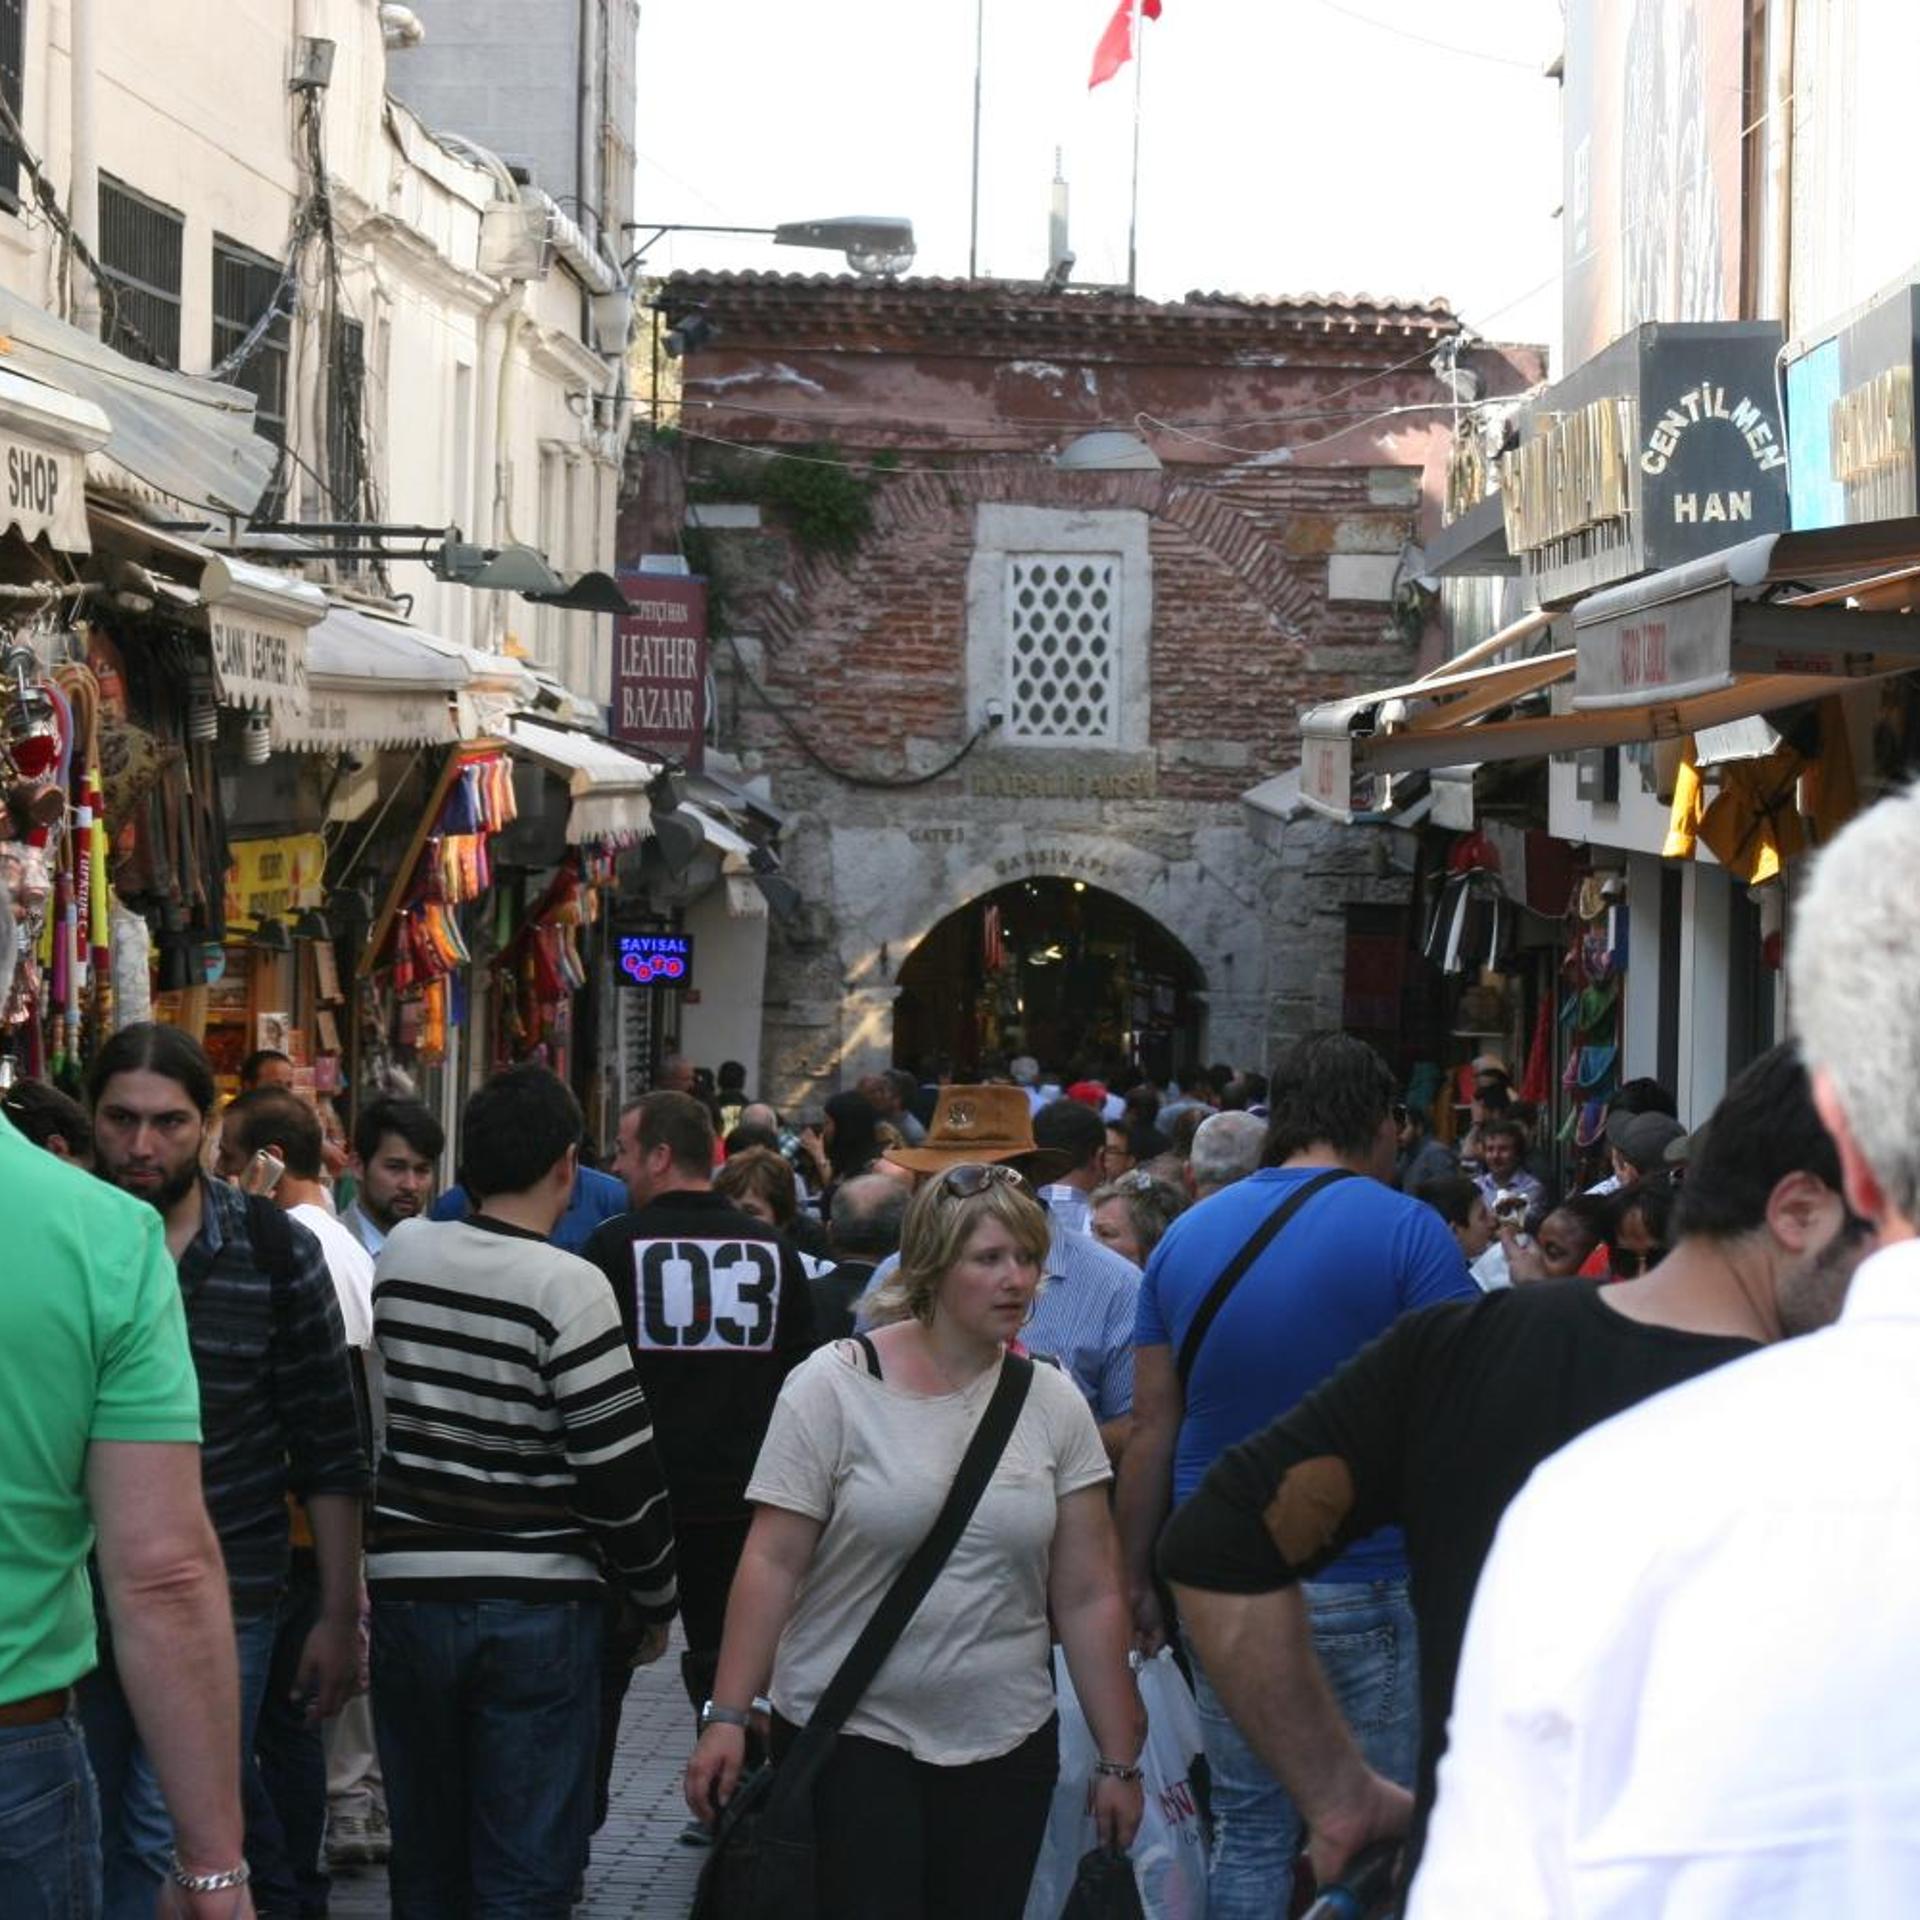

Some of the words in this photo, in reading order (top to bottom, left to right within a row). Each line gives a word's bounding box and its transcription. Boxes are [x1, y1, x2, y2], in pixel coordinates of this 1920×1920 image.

[8, 446, 59, 517] SHOP
[1673, 490, 1753, 524] HAN
[620, 634, 699, 680] LEATHER
[622, 686, 695, 730] BAZAAR
[642, 1242, 777, 1346] 03
